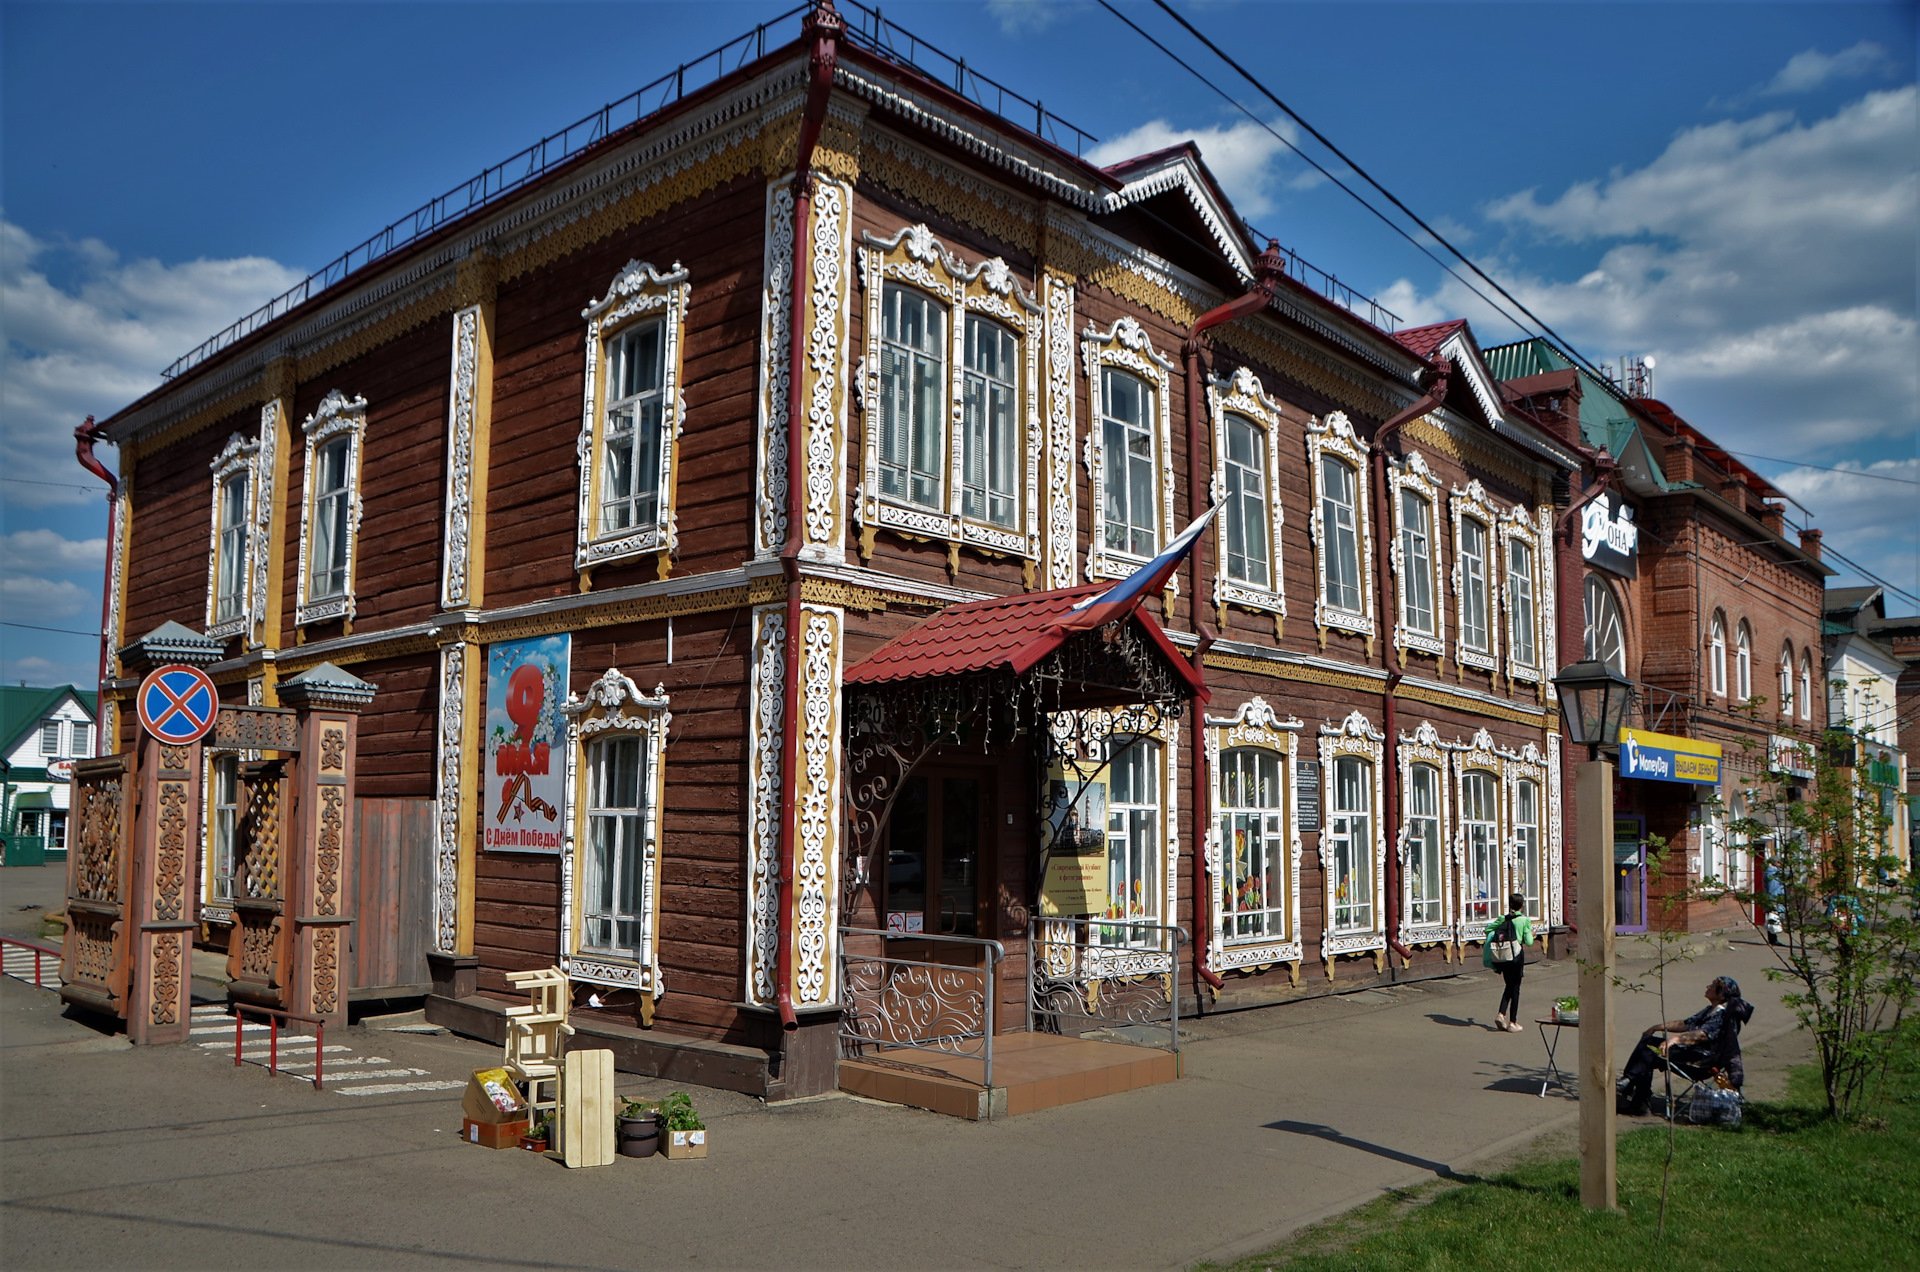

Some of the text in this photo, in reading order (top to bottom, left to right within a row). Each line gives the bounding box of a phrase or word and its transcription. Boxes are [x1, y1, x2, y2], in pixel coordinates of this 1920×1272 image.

[1638, 753, 1669, 777] MoneyDay
[1675, 759, 1697, 774] ВЫДАЕМ
[486, 828, 492, 845] С
[493, 827, 518, 848] Днём
